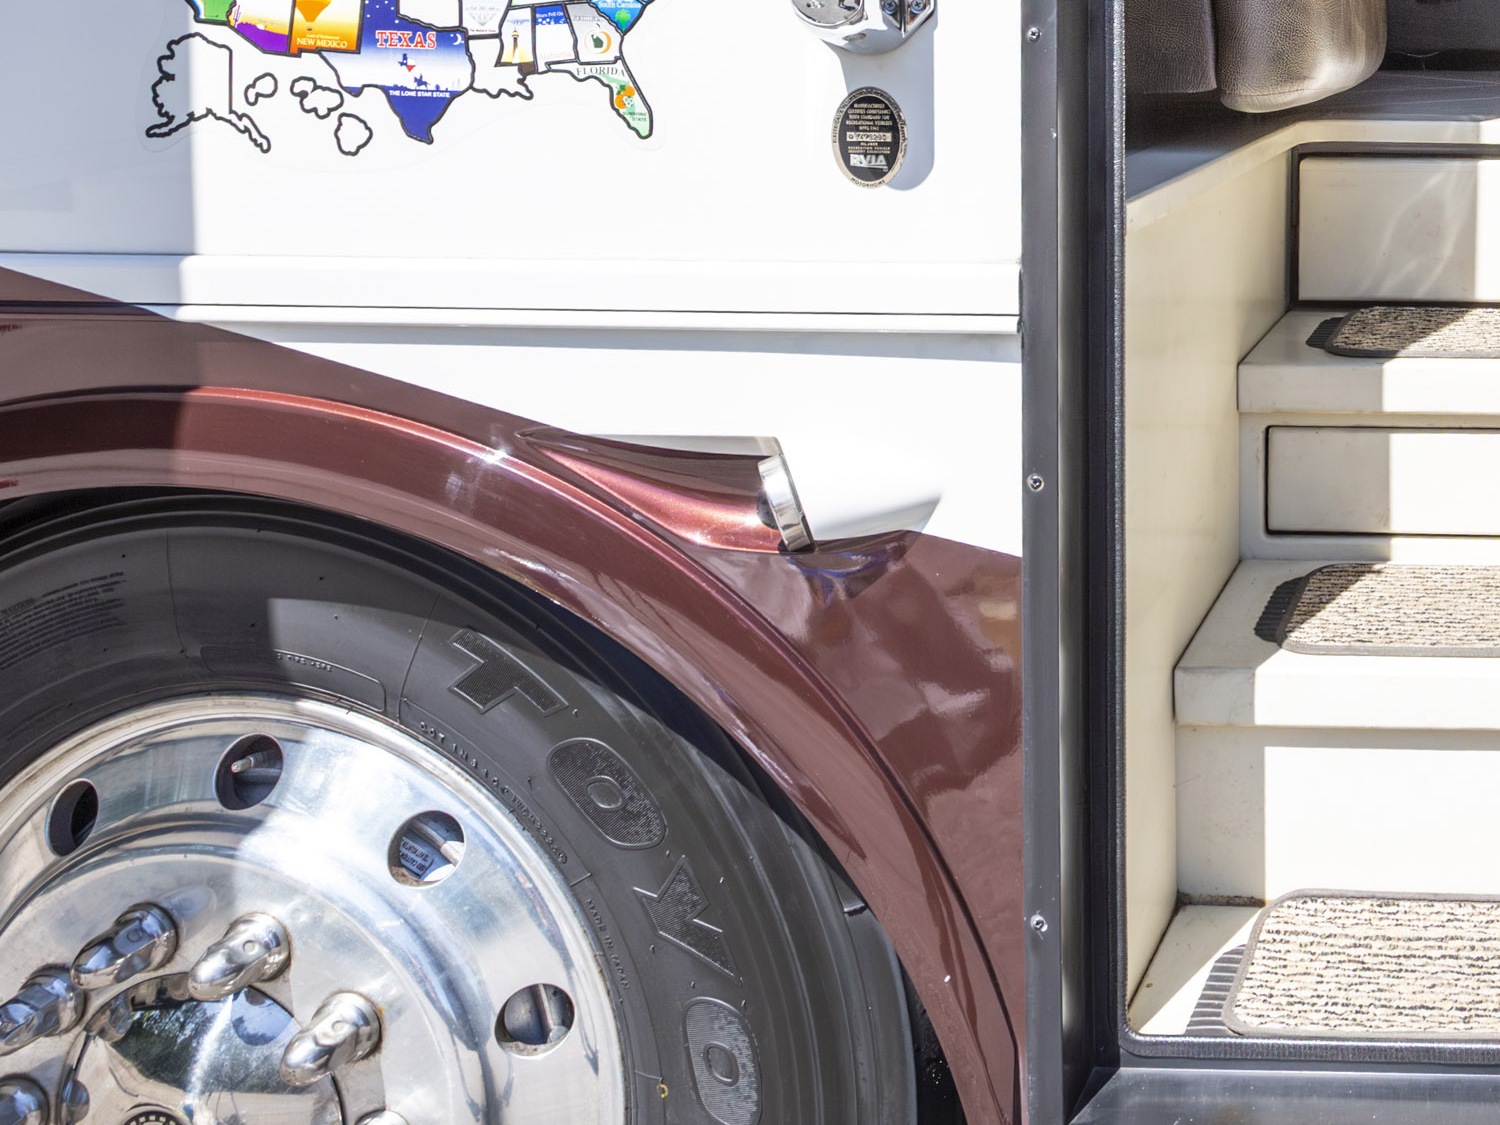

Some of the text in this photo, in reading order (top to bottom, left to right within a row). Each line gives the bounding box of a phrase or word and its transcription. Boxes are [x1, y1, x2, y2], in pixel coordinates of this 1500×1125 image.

[598, 1, 641, 9] South Carolina
[297, 37, 348, 48] NEW MEXICO
[376, 30, 437, 49] TEXAS
[576, 66, 625, 76] FLORIDA
[850, 177, 886, 187] MOTORHOME
[447, 626, 763, 1125] TOYO
[585, 898, 607, 934] MADE
